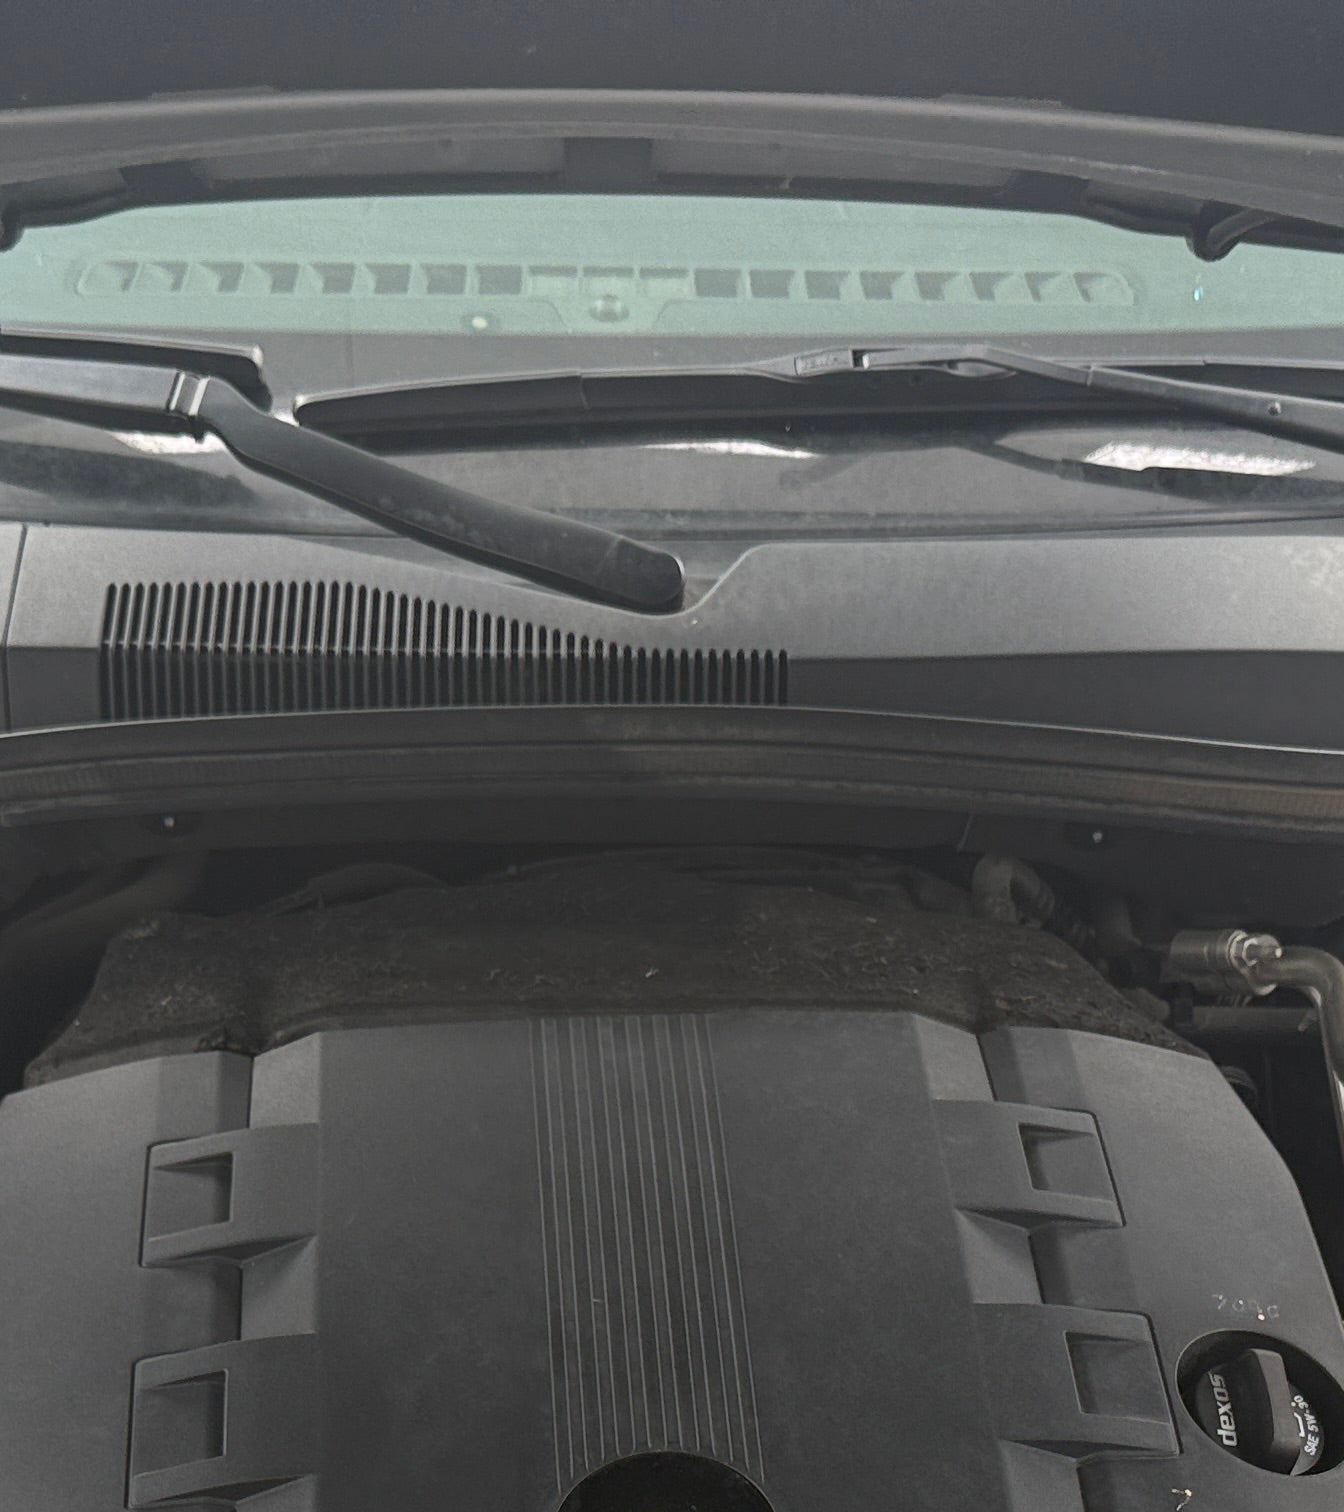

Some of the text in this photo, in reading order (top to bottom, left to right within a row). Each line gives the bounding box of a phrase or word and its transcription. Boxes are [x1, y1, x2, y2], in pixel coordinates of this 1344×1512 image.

[1208, 1371, 1238, 1447] dexos
[1293, 1394, 1320, 1456] SAE 5W-30
